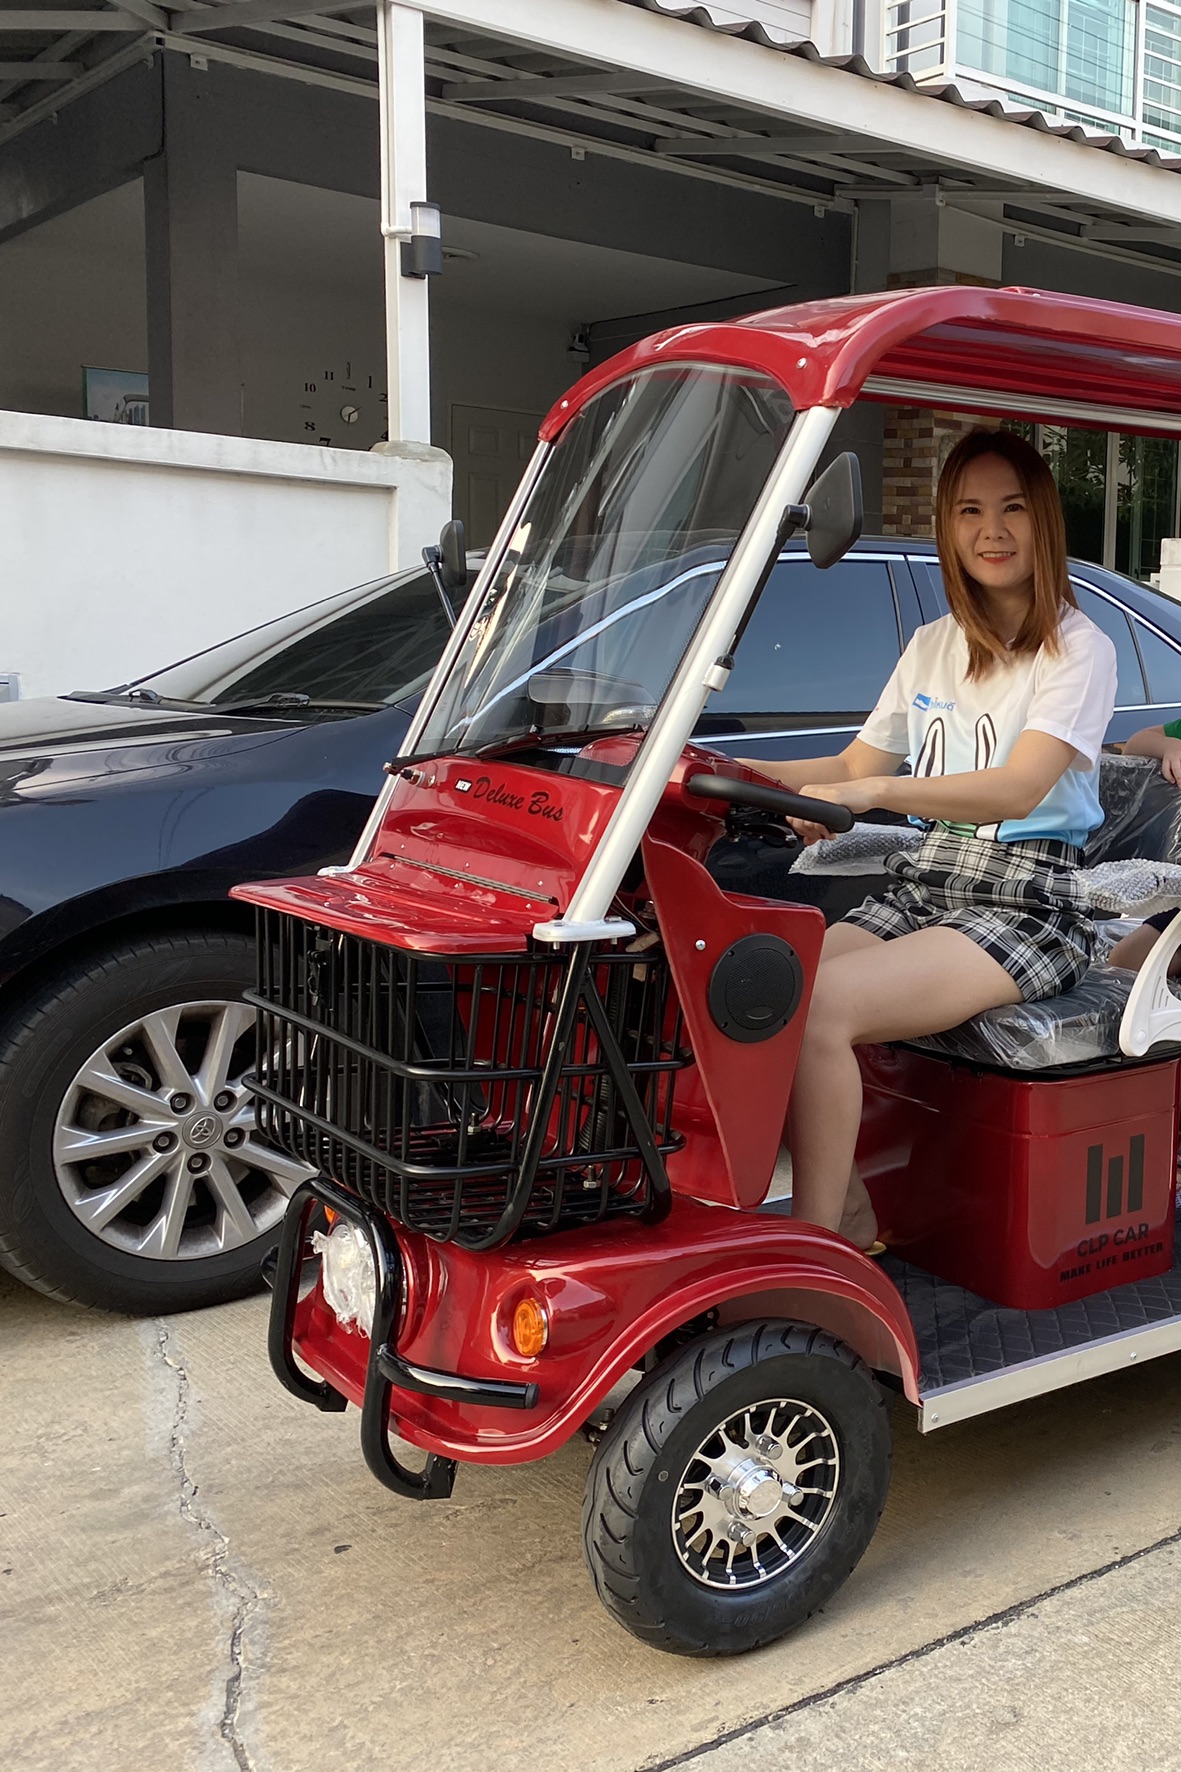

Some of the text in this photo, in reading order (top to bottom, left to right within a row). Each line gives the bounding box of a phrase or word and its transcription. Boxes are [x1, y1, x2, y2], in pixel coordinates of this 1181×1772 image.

[304, 382, 317, 393] 10
[304, 421, 316, 432] 8
[473, 777, 525, 810] Deluxe
[528, 791, 563, 821] Bus
[1077, 1223, 1149, 1257] CLP CAR
[1060, 1242, 1163, 1282] MAKE LIFE BETTER
